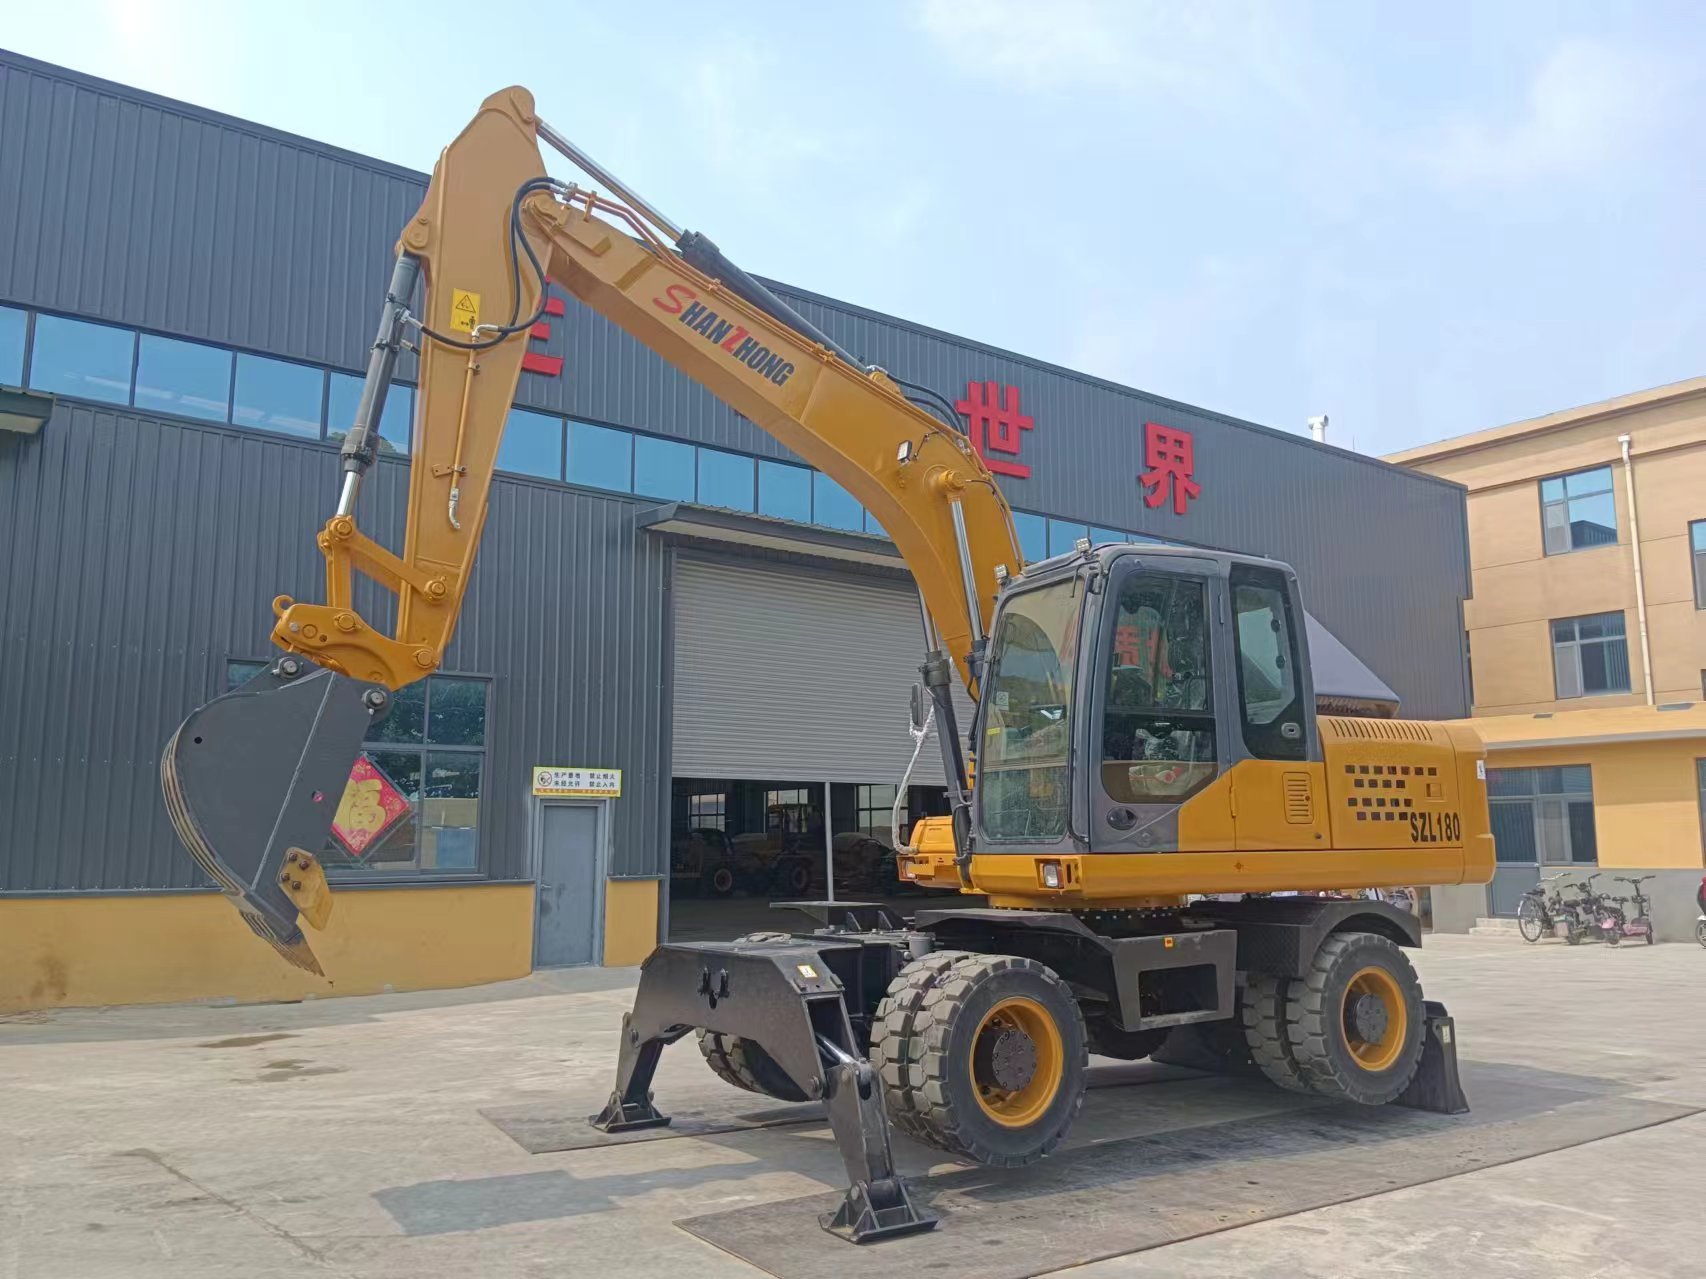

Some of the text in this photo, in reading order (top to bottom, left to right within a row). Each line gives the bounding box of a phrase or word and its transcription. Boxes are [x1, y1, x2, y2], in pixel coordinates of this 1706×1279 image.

[652, 284, 795, 387] SHANZHONG
[333, 778, 387, 834] 福
[1410, 811, 1461, 842] SZL180
